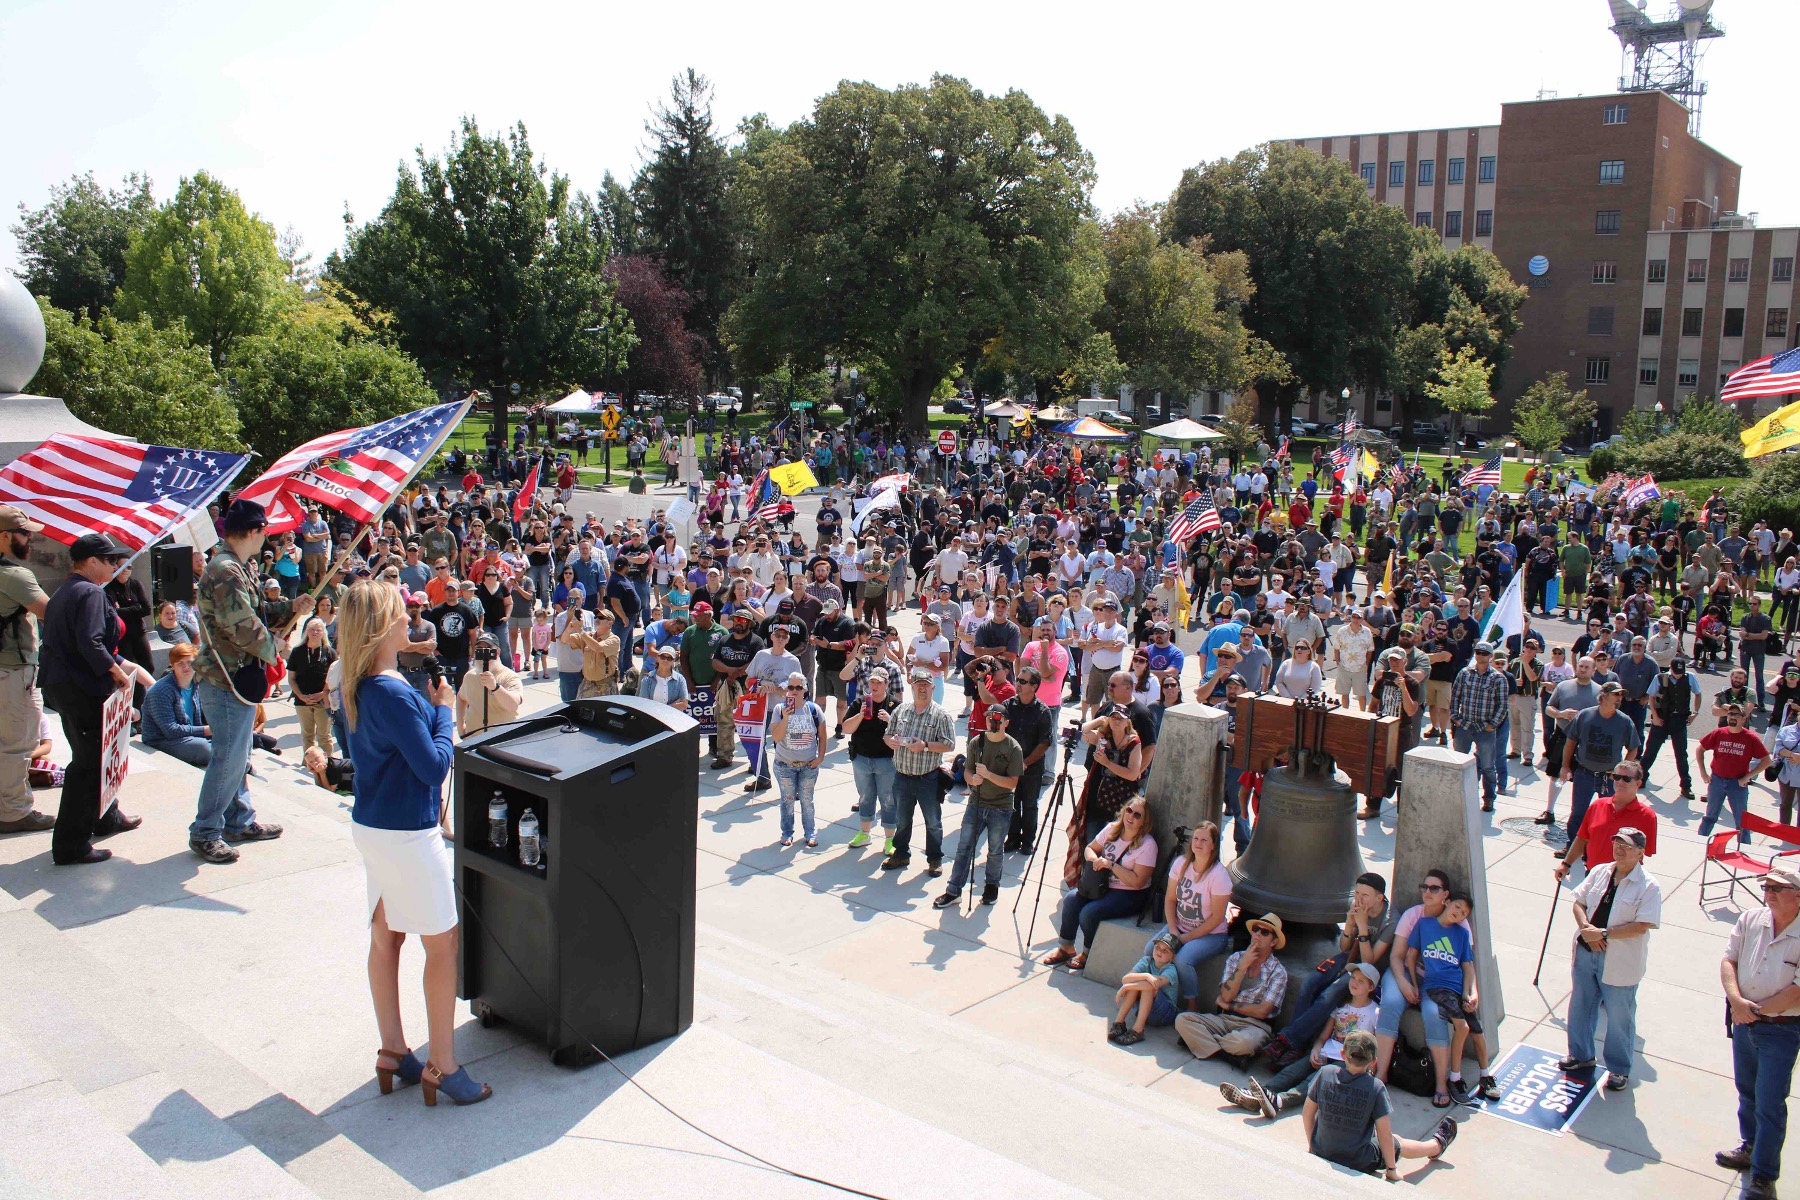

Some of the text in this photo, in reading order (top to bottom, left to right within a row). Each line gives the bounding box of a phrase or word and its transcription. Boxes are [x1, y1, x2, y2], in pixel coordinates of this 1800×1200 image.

[1423, 949, 1459, 965] adidas
[1497, 1055, 1561, 1115] FULCHER
[1539, 1075, 1588, 1114] RUSS
